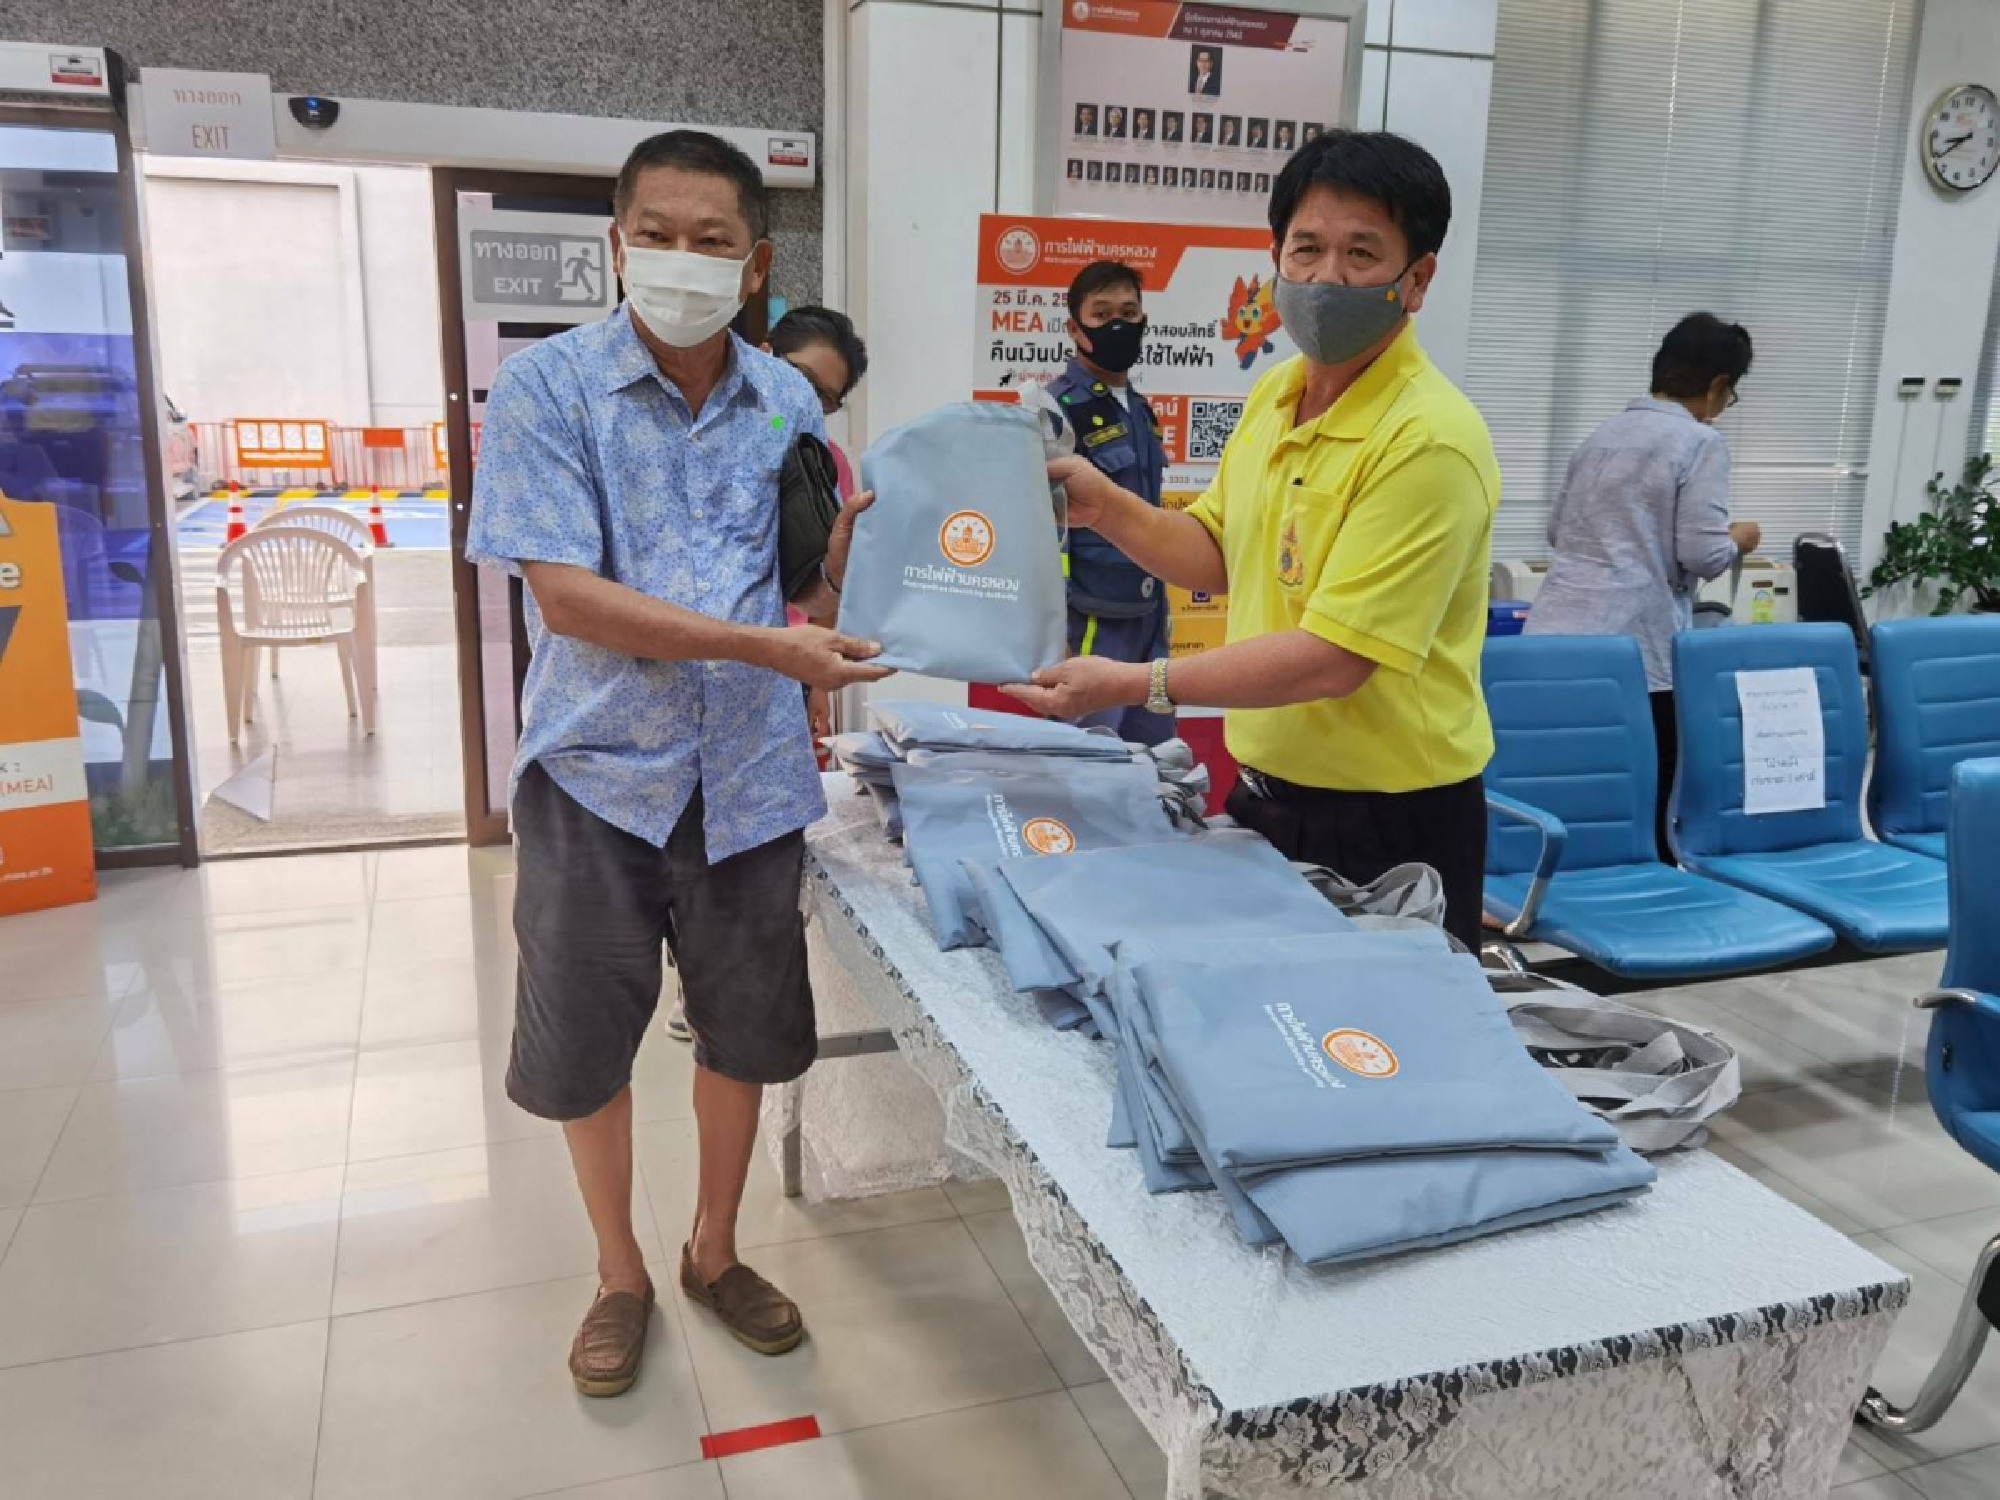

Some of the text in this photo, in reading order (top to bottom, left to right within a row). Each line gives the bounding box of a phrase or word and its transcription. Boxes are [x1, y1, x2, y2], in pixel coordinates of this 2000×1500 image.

[172, 89, 242, 107] ทางออก
[191, 124, 229, 151] EXIT
[474, 241, 558, 261] ทางออก
[1044, 236, 1158, 259] การไฟฟ้านครหลวง
[493, 276, 543, 296] EXIT
[992, 289, 1012, 306] 25
[991, 309, 1044, 333] MEA
[904, 563, 1020, 592] การไฟฟ้านครหลวง
